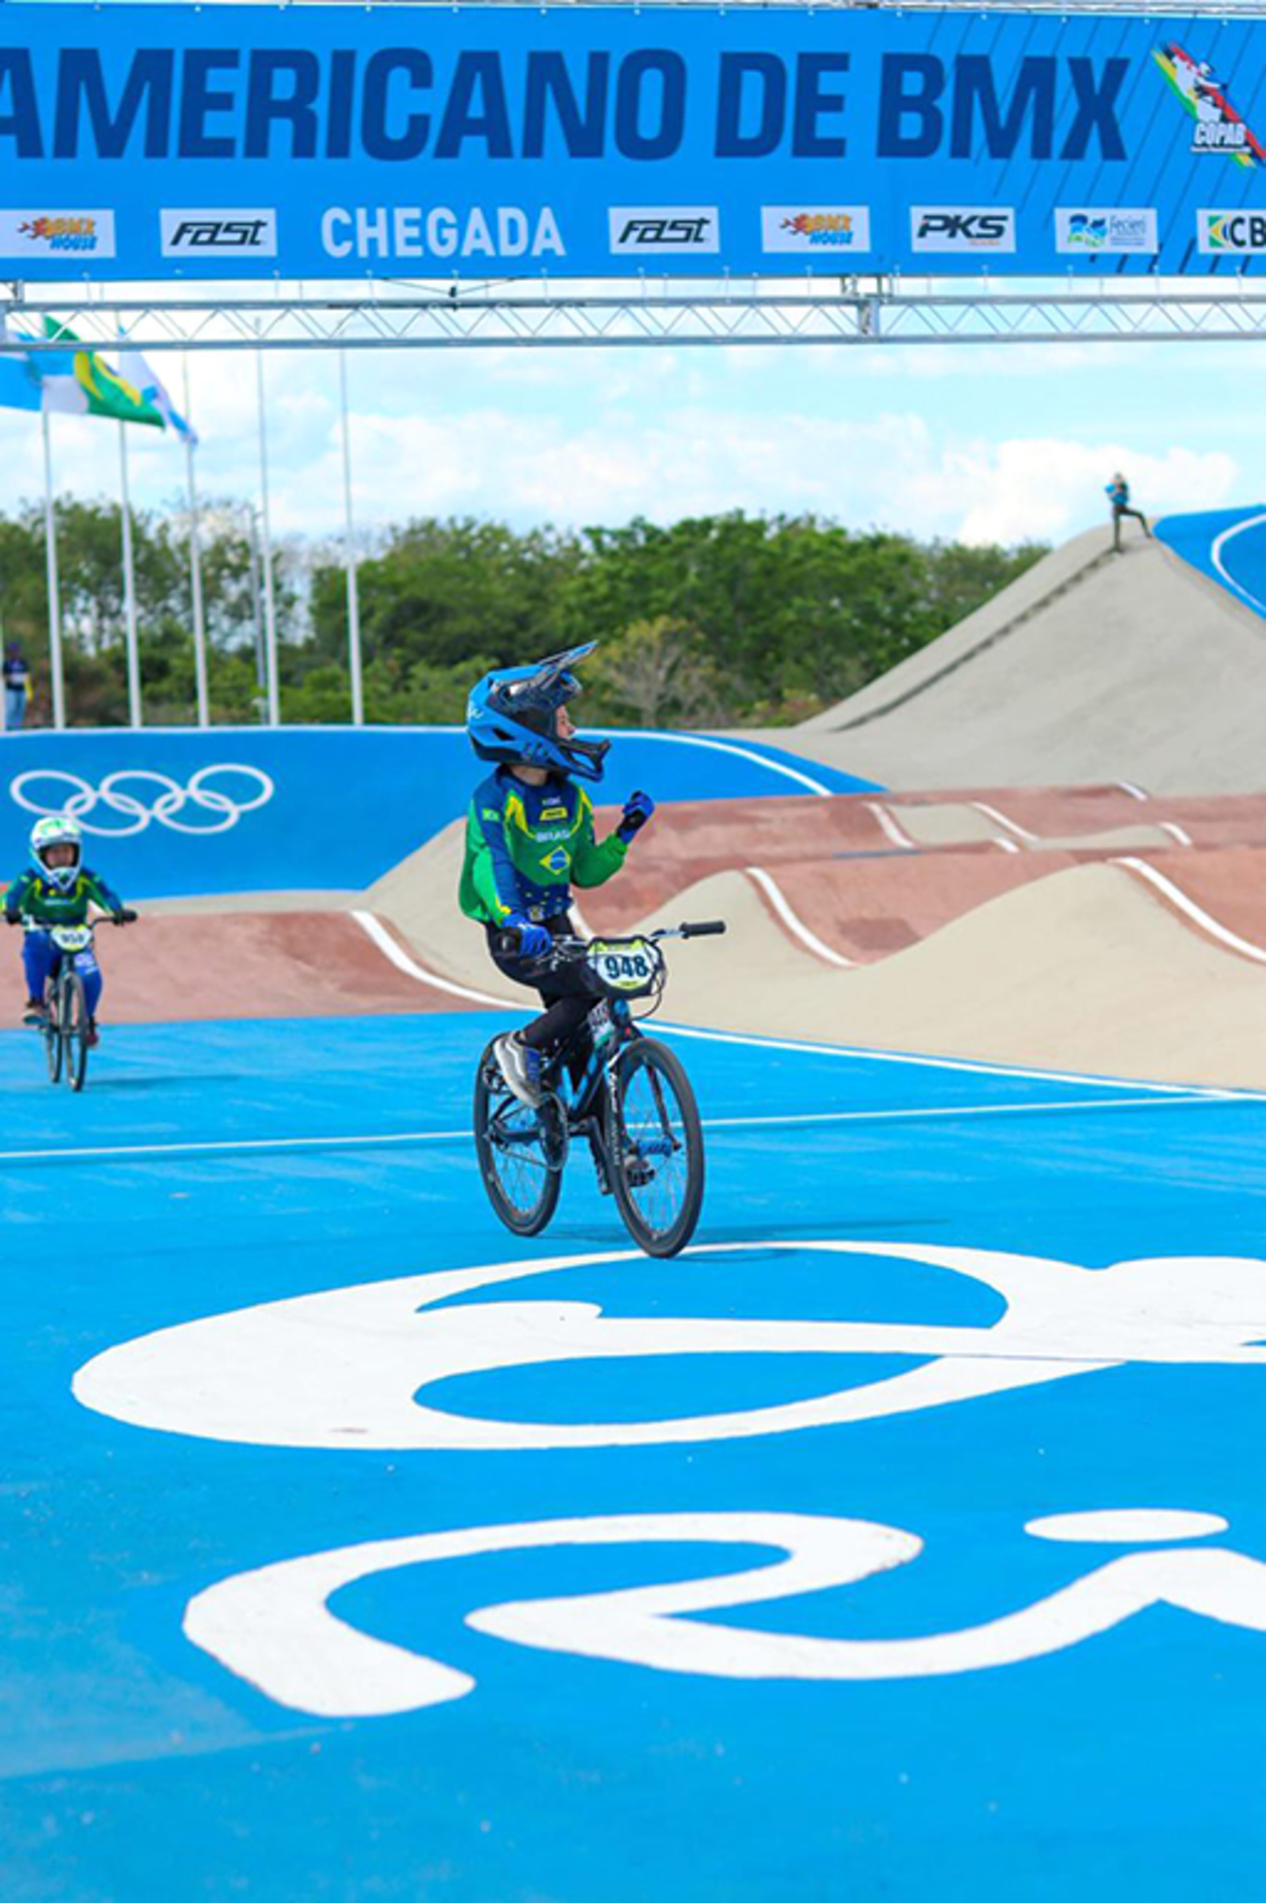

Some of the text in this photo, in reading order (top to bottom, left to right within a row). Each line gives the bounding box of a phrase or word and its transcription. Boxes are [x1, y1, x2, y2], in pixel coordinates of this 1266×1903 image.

[0, 47, 1130, 162] AMERICANO DE BMX
[321, 207, 566, 258] CHEGADA
[809, 230, 854, 246] HOUSE
[917, 214, 1009, 239] PKS
[49, 233, 98, 251] HOUSE
[604, 955, 650, 979] 948
